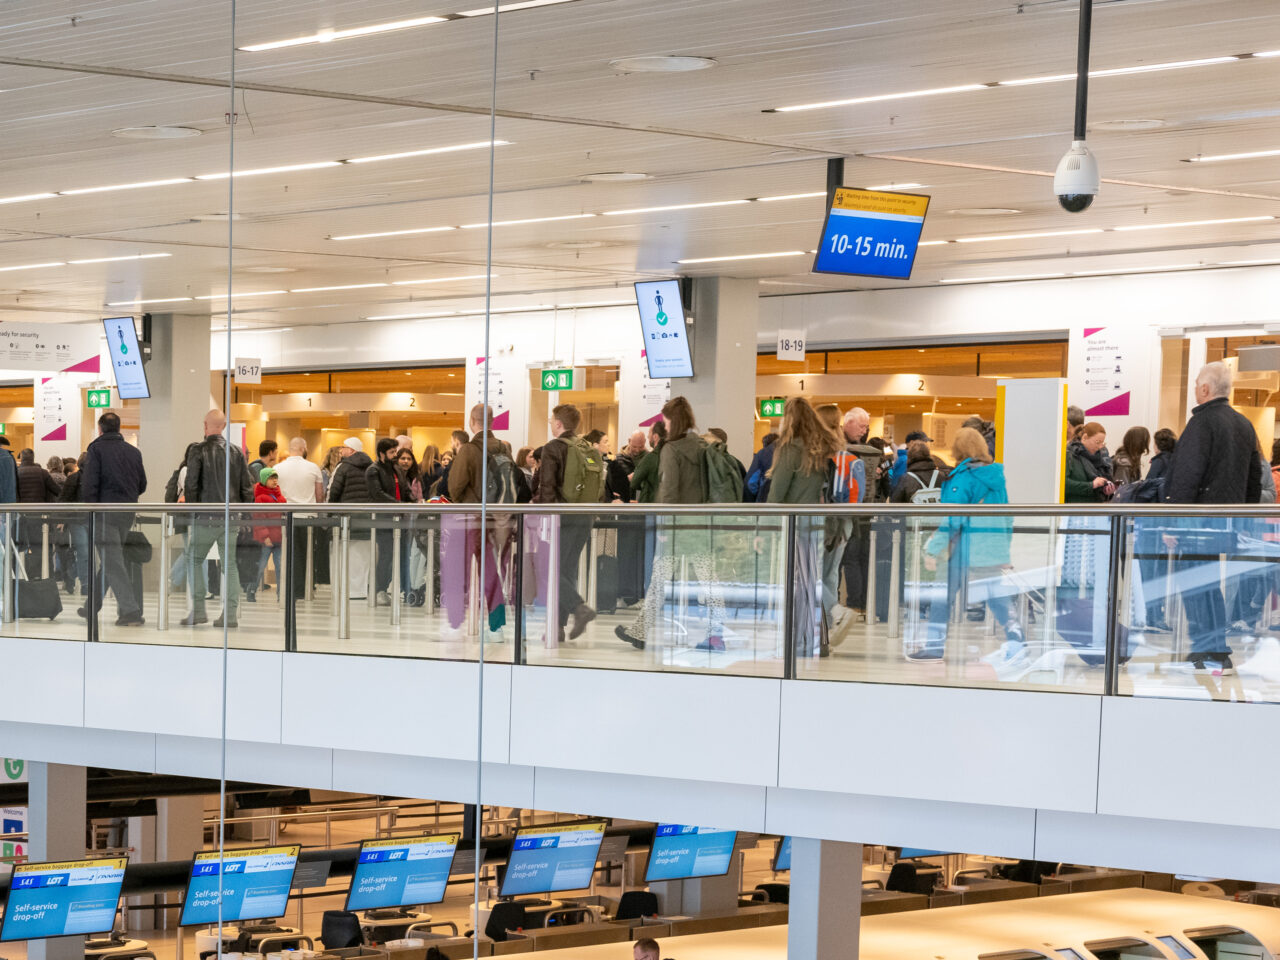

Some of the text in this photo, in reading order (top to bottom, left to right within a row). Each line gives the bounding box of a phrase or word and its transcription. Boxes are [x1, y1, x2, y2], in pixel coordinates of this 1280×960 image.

[831, 234, 908, 259] 10-15 min.
[19, 331, 39, 339] security
[780, 339, 803, 352] 18-19
[237, 365, 259, 376] 16-17
[799, 380, 804, 391] 1
[918, 380, 925, 391] 2
[307, 398, 312, 407] 1
[409, 398, 416, 407] 2
[541, 839, 556, 847] LOT
[289, 847, 296, 856] 2
[388, 851, 405, 859] LOT
[657, 848, 689, 857] Self-service
[654, 856, 680, 865] drop-off
[23, 860, 123, 872] Self-service baggage drop-off 1
[199, 865, 214, 873] SAS
[224, 864, 242, 872] LOT
[514, 862, 549, 871] Self-service
[511, 870, 538, 879] drop-off
[19, 877, 34, 886] SAS
[46, 876, 65, 885] LOT
[360, 876, 398, 885] Self-service
[358, 883, 386, 893] drop-off
[14, 902, 58, 913] Self-service
[12, 911, 45, 922] drop-off
